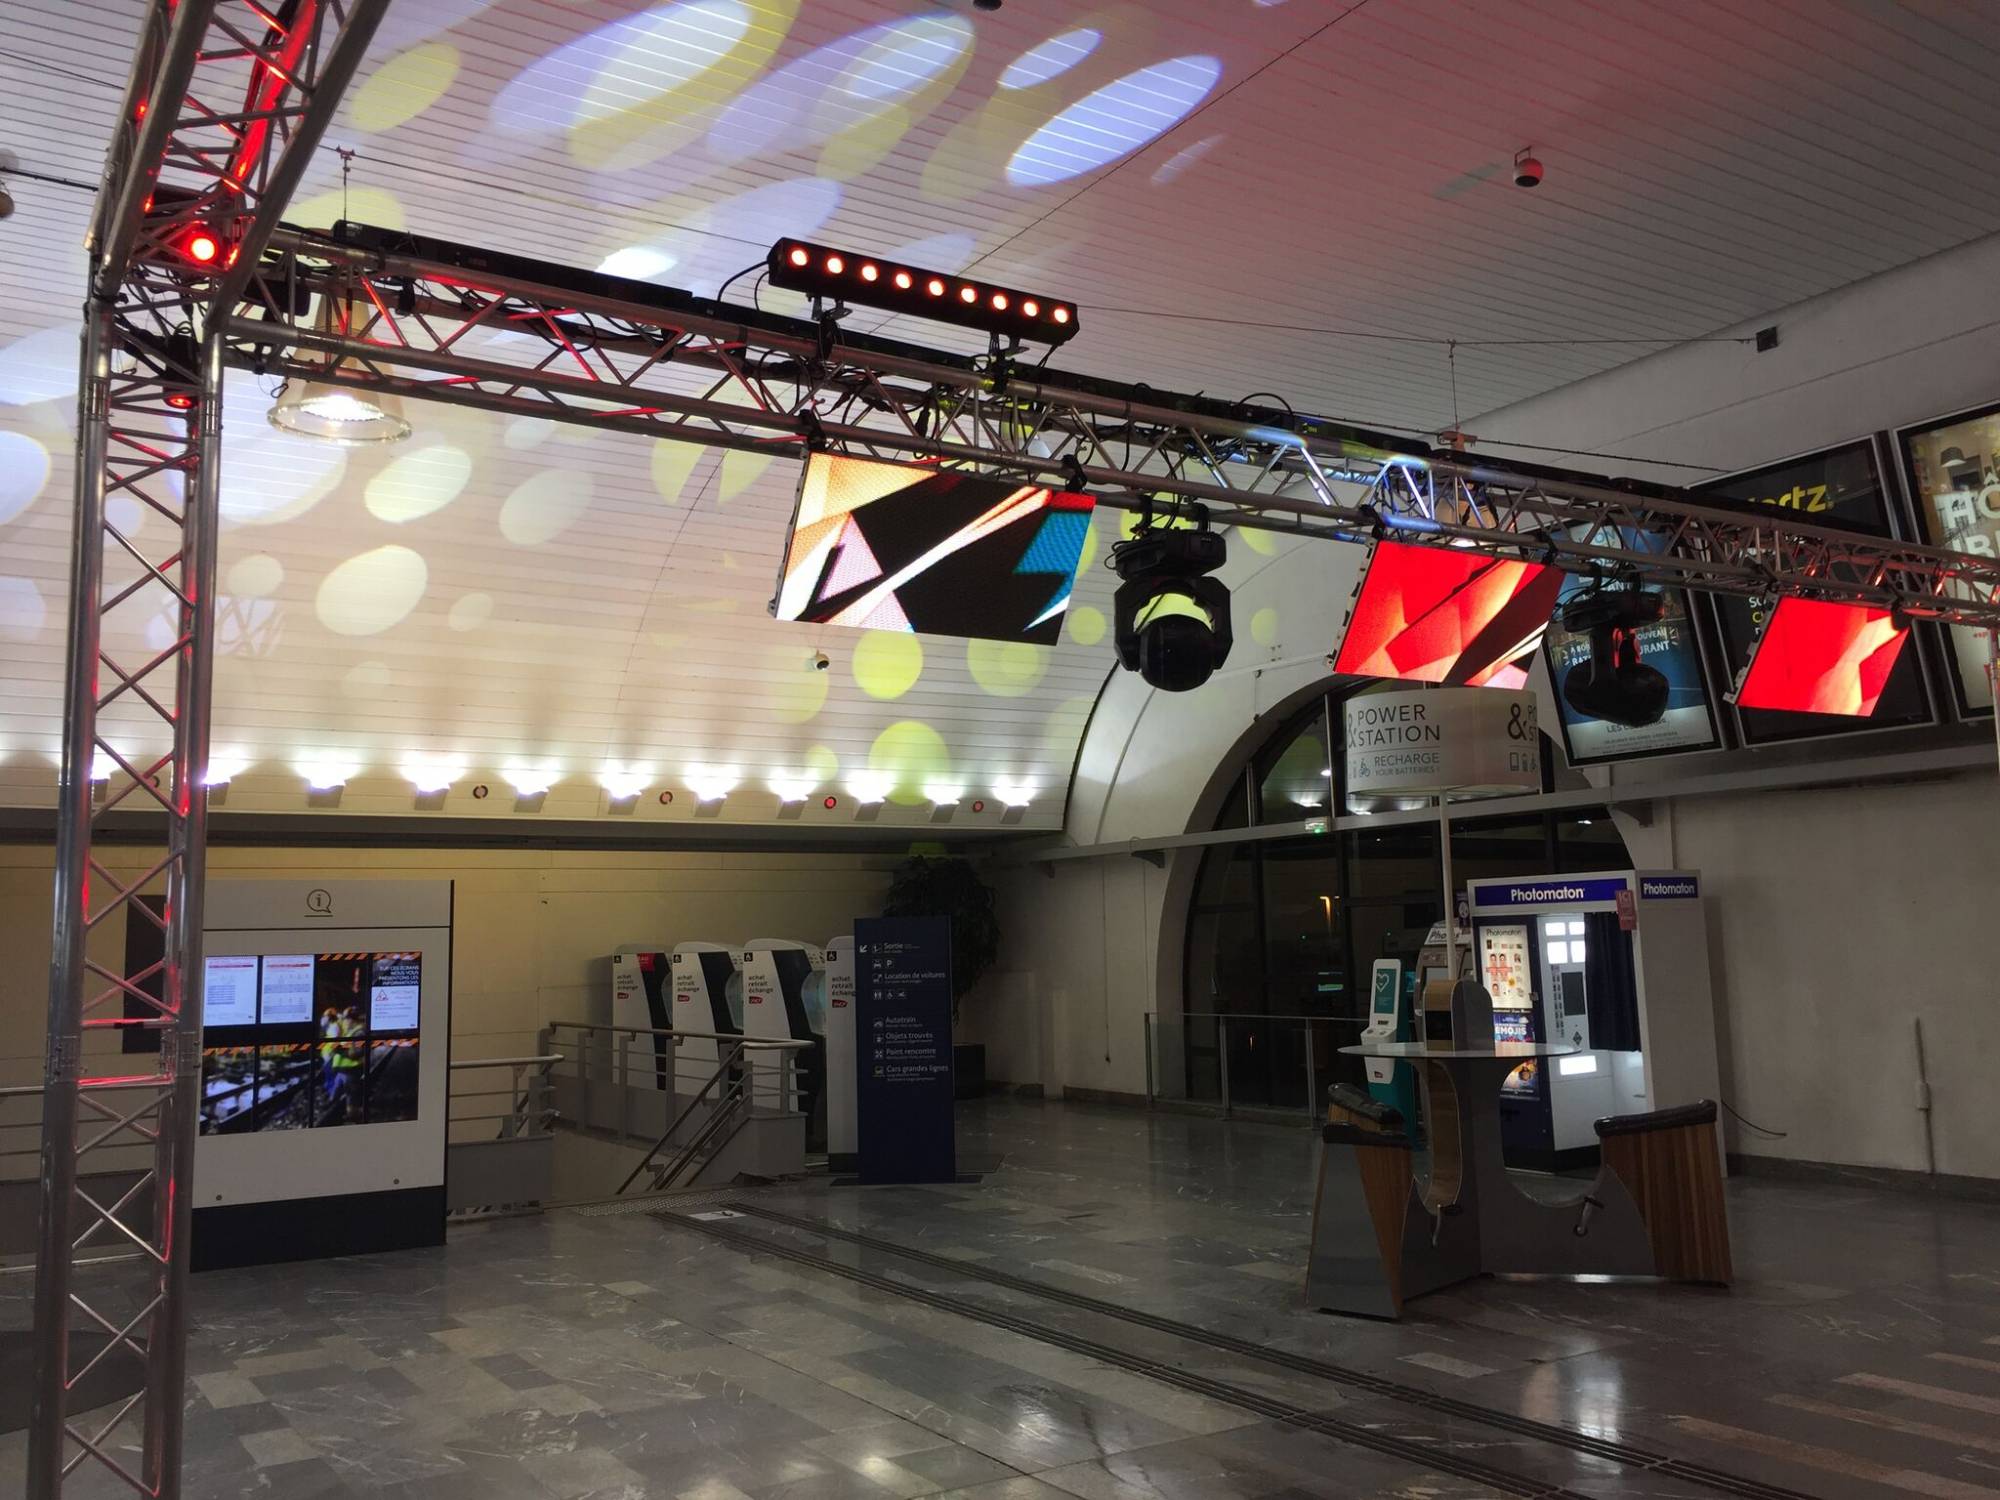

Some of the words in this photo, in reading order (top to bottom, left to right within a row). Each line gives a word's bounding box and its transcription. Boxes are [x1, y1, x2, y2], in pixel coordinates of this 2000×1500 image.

[1358, 704, 1426, 725] POWER
[1358, 724, 1440, 747] STATION
[1374, 752, 1440, 767] RECHARGE
[1510, 886, 1585, 902] Photomaton
[1643, 882, 1696, 896] Photomaton
